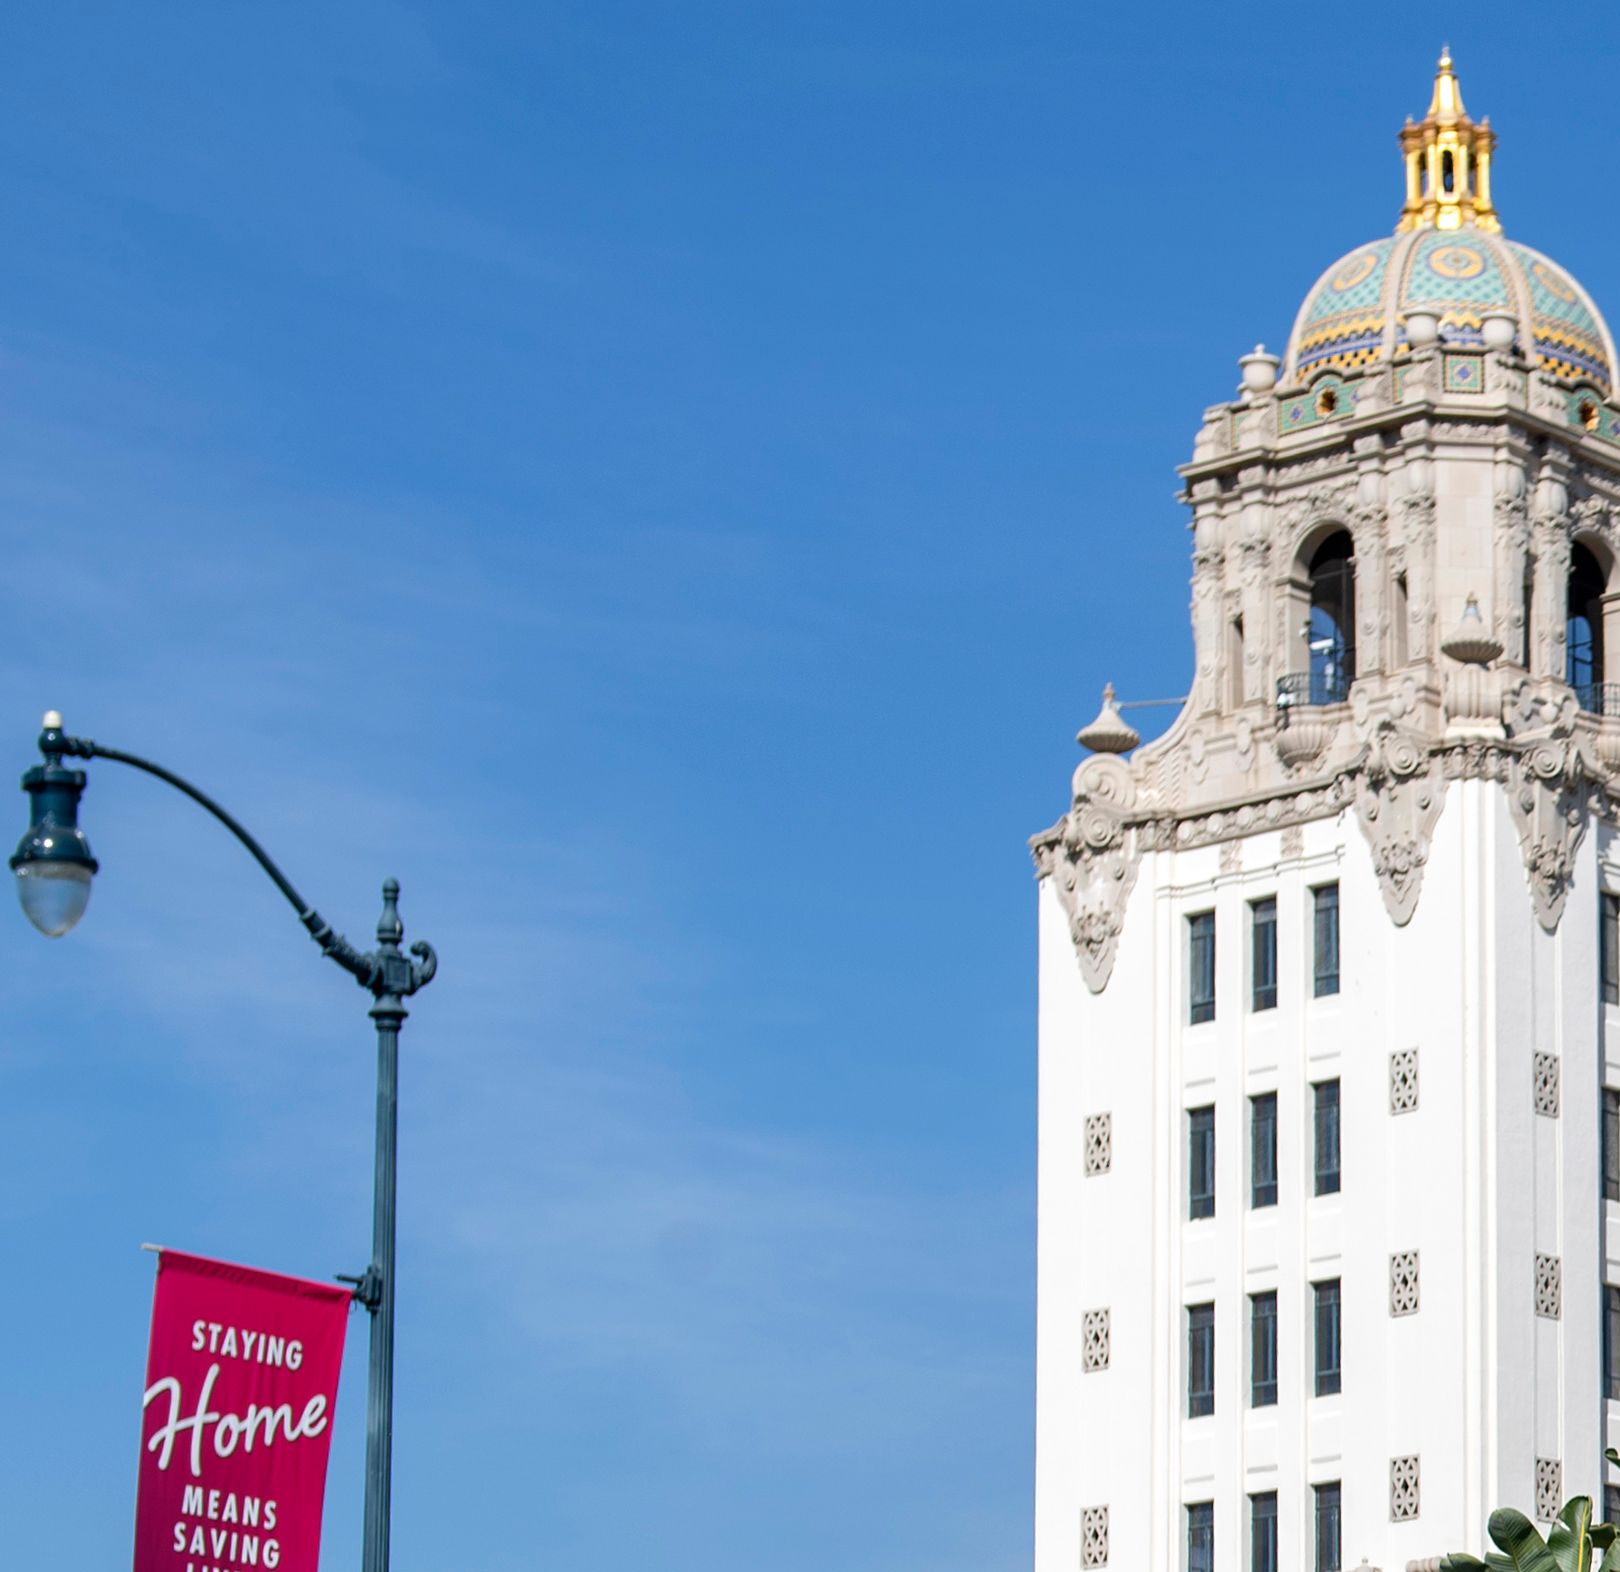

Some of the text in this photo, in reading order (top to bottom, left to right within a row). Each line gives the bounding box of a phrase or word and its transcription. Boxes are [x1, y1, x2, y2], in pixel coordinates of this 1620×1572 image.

[191, 1320, 304, 1371] STAYING
[143, 1362, 328, 1478] Home
[181, 1484, 278, 1531] MEANS
[173, 1521, 280, 1570] SAVING
